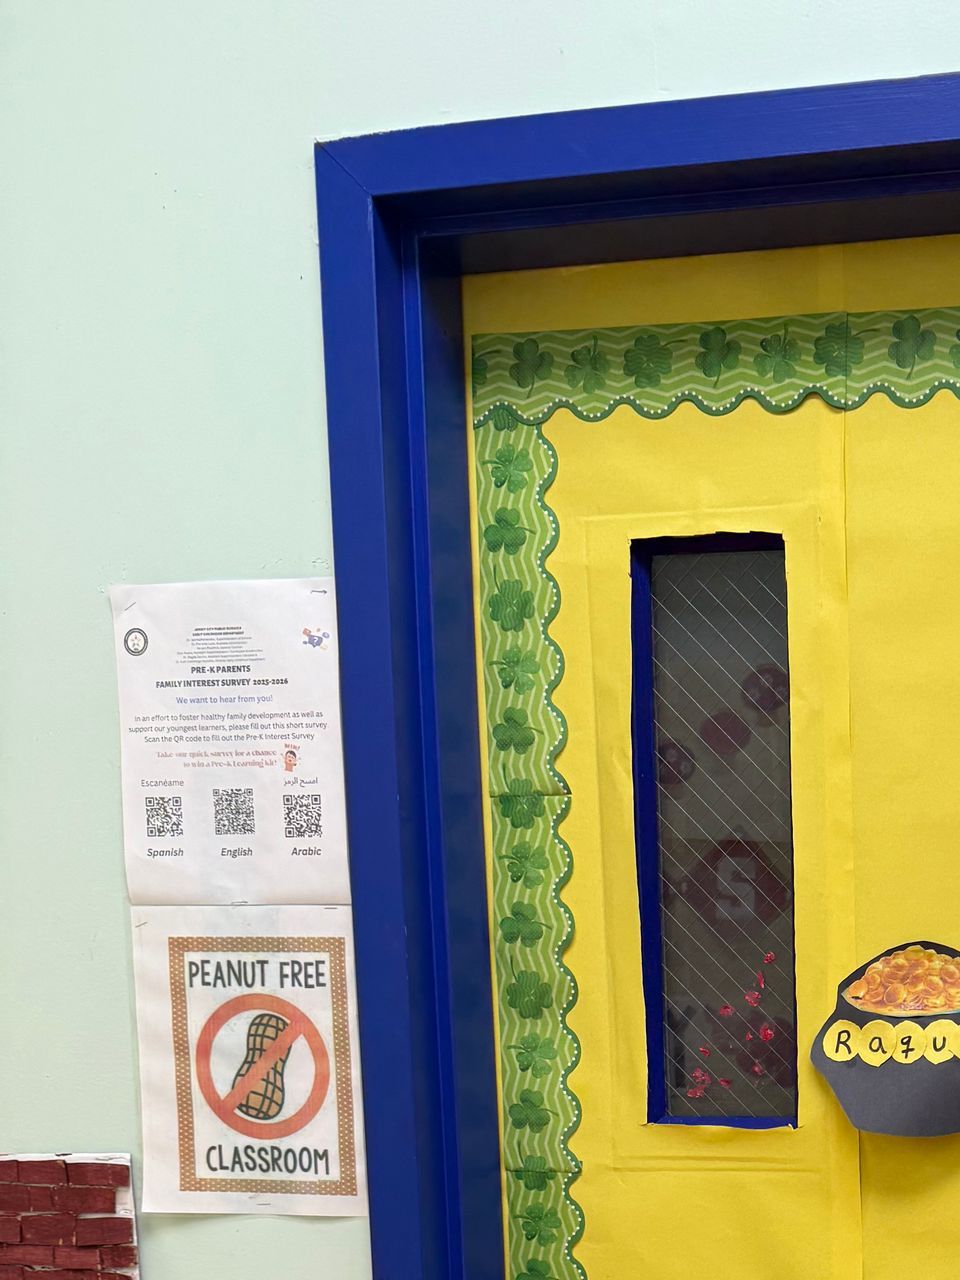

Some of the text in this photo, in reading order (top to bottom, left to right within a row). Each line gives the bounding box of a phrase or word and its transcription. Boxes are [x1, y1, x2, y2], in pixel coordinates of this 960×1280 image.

[216, 665, 251, 673] PARENTS
[219, 695, 236, 703] hear
[200, 713, 225, 722] healthy
[226, 713, 247, 721] family
[247, 712, 291, 720] development
[166, 725, 198, 733] youngest
[304, 722, 328, 730] survey
[173, 735, 184, 743] QR
[291, 732, 315, 740] Survey
[141, 779, 185, 787] Escanéame
[146, 847, 184, 858] Spanish
[221, 847, 253, 858] English
[291, 847, 322, 856] Arabic
[188, 959, 327, 989] PEANUT FREE
[206, 1144, 330, 1176] CLASSROOM
